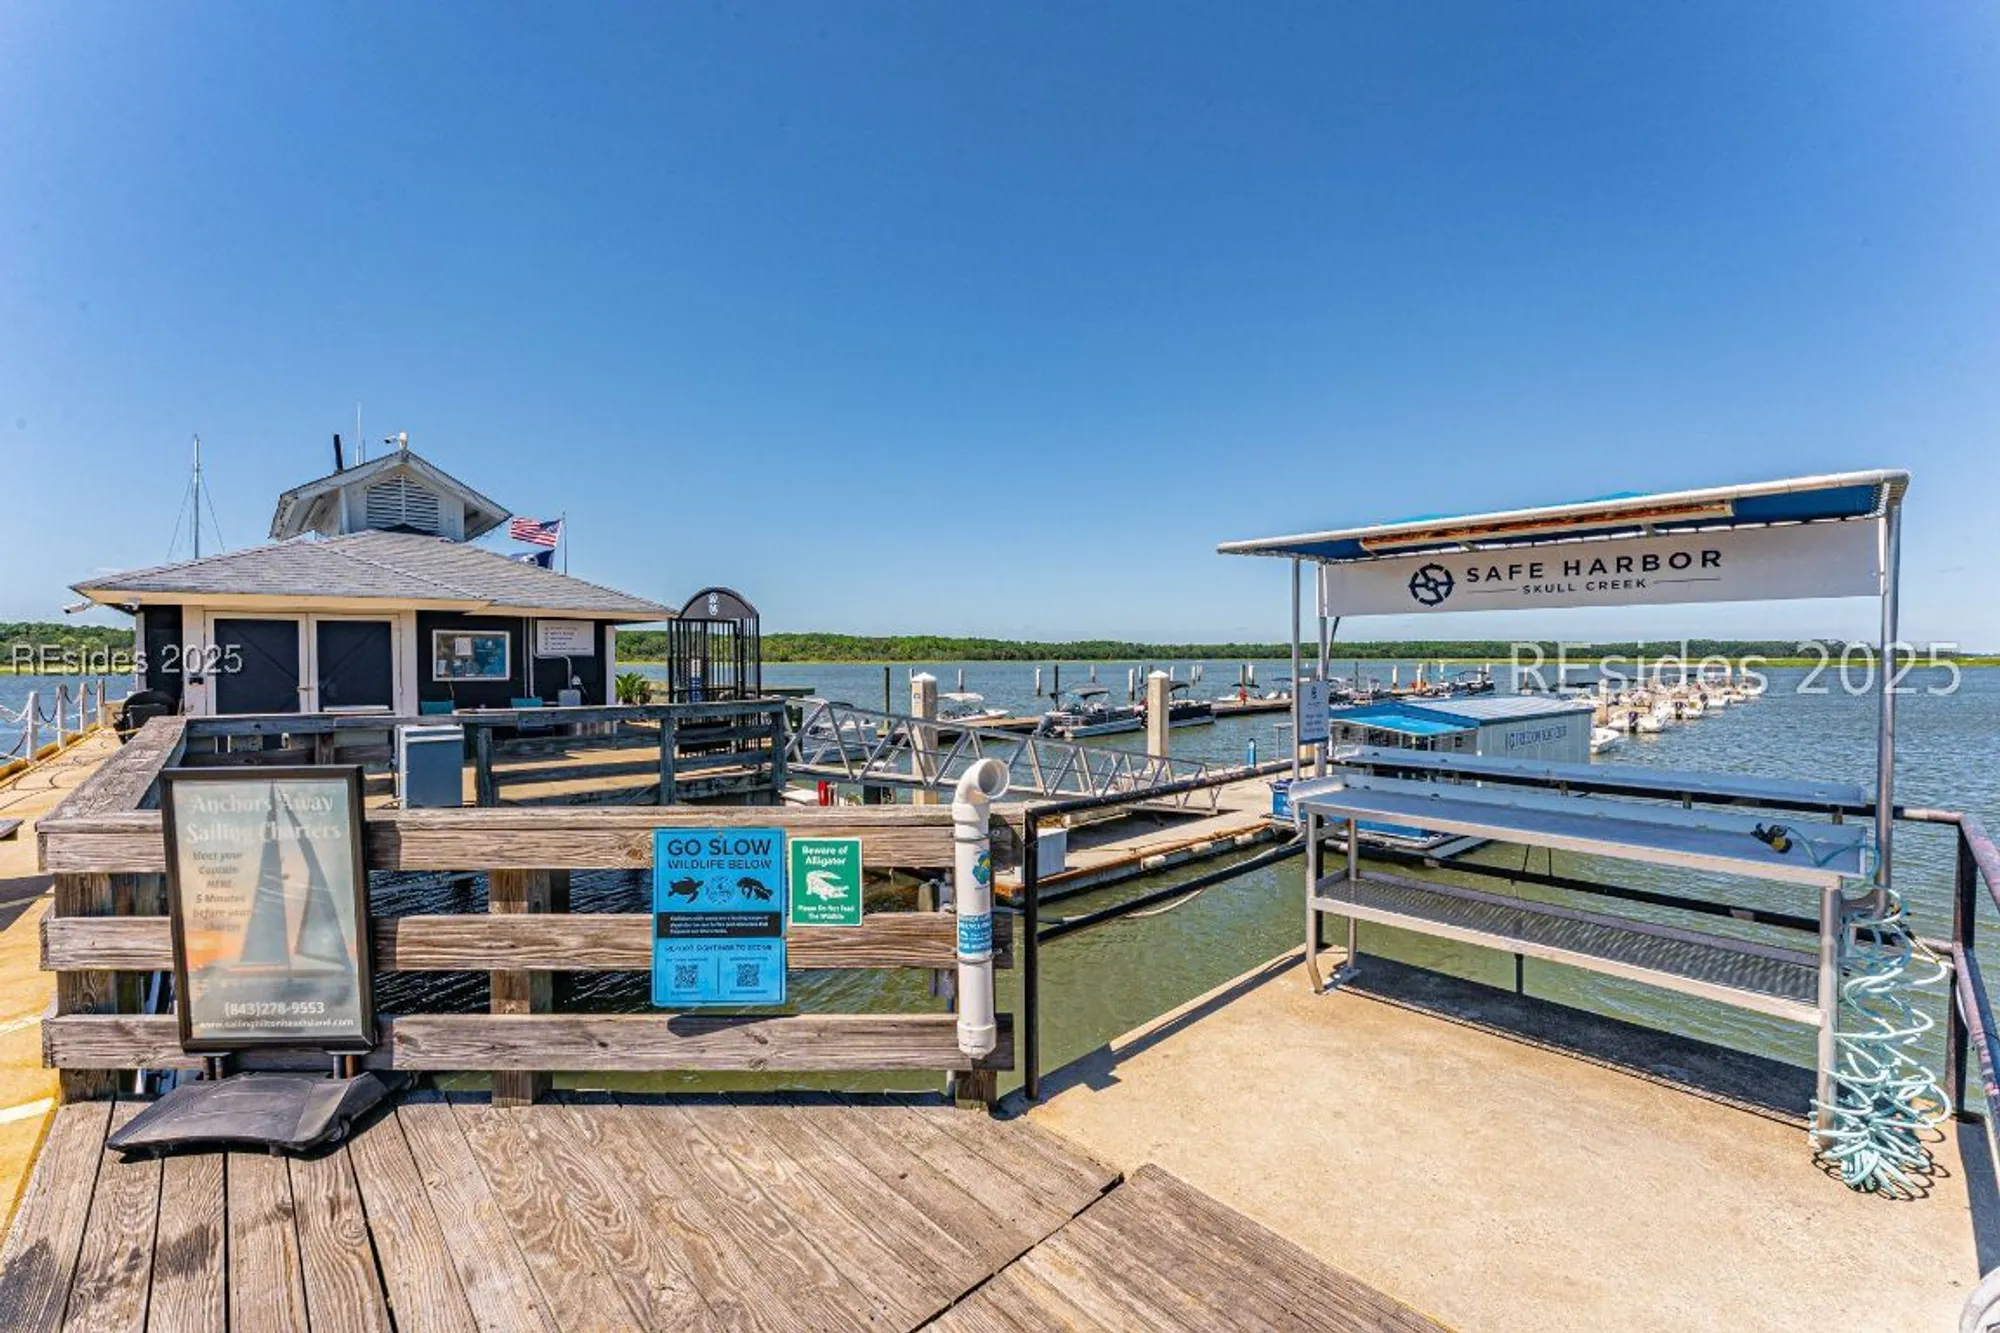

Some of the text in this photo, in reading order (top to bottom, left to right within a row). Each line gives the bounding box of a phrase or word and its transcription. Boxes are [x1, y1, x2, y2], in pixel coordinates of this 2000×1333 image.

[1466, 550, 1723, 583] SAFE HARBOR
[1522, 578, 1647, 596] SKULL CREEK
[189, 791, 334, 815] Anchors Away
[186, 821, 341, 844] Sailing Charters
[667, 838, 772, 857] GO SLOW
[801, 845, 849, 856] Beware of
[668, 859, 773, 870] WILDLIFE BELOW
[805, 856, 847, 868] Alligator
[196, 894, 202, 904] 5
[224, 1001, 326, 1017] (843)278-9553
